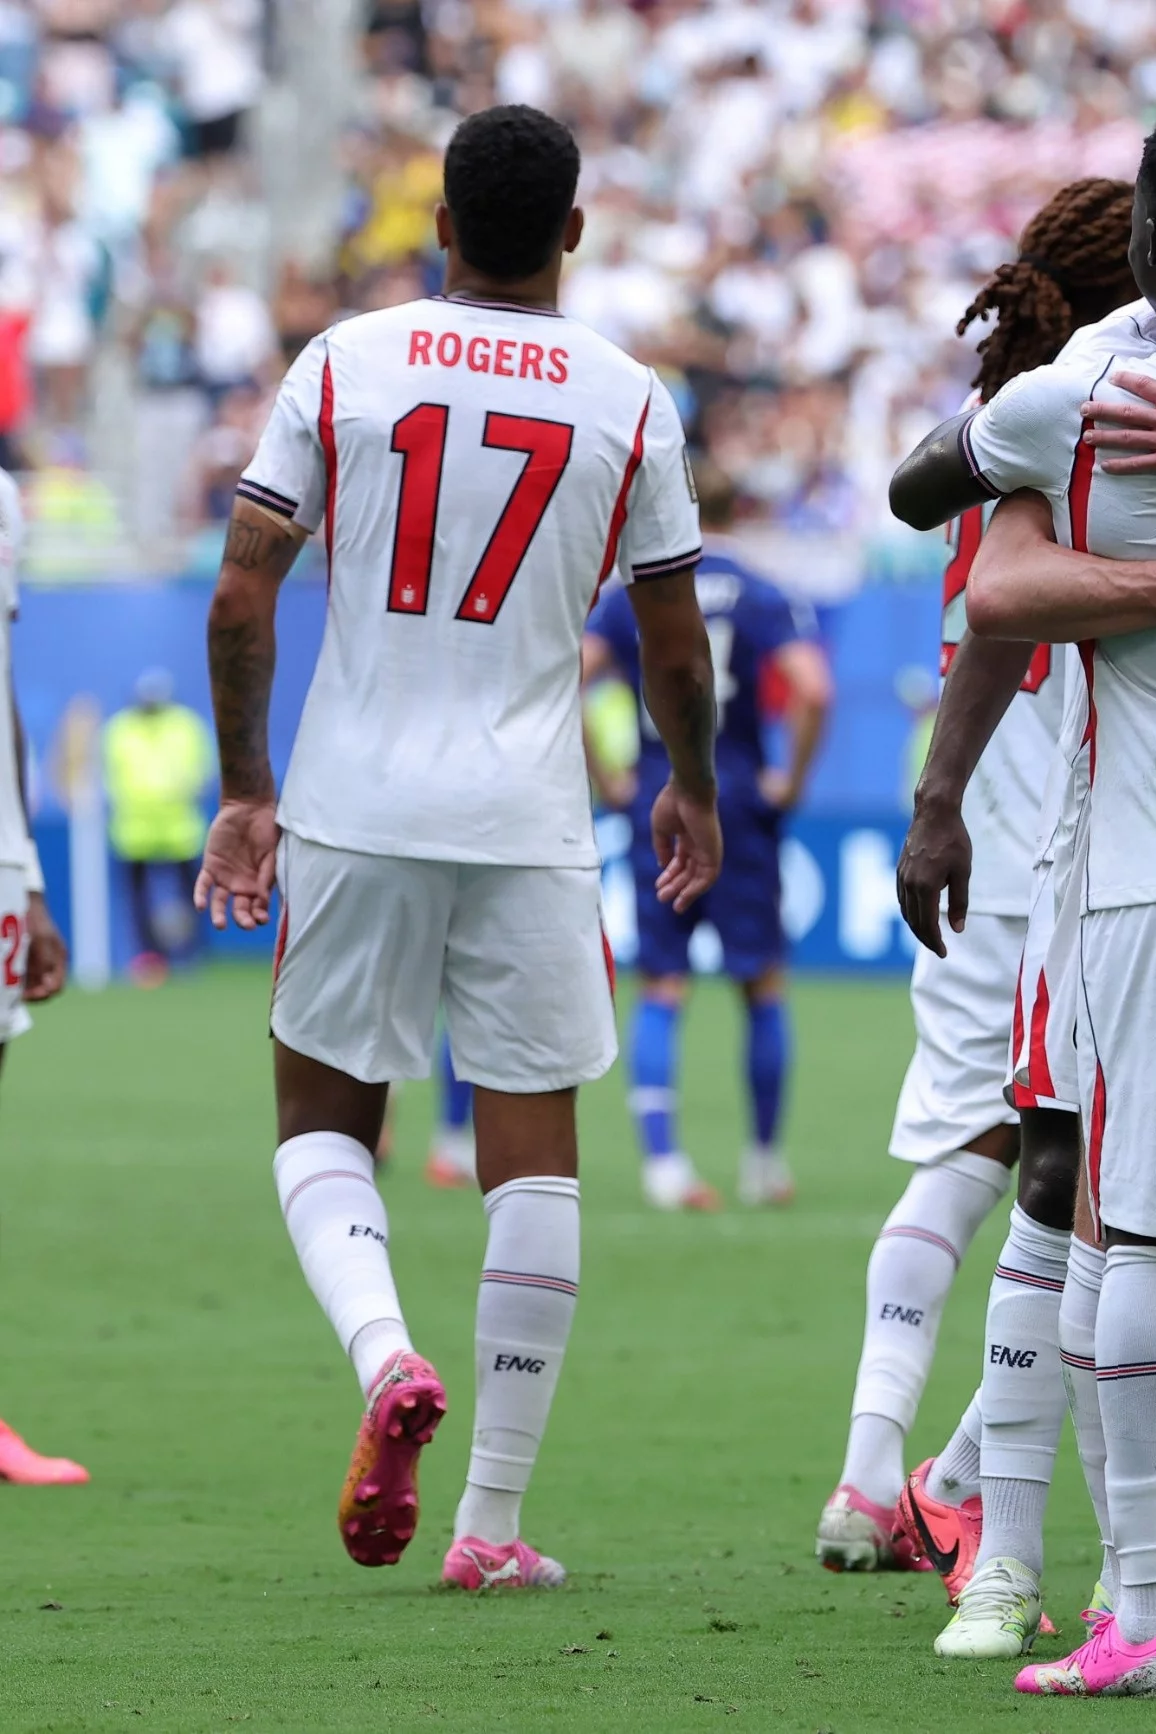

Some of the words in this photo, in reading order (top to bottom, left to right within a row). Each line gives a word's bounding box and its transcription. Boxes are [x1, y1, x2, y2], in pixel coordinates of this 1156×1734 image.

[407, 330, 569, 384] ROGERS
[387, 402, 574, 625] 17
[881, 1303, 924, 1327] ENG
[493, 1353, 546, 1375] ENG
[990, 1344, 1038, 1369] ENG
